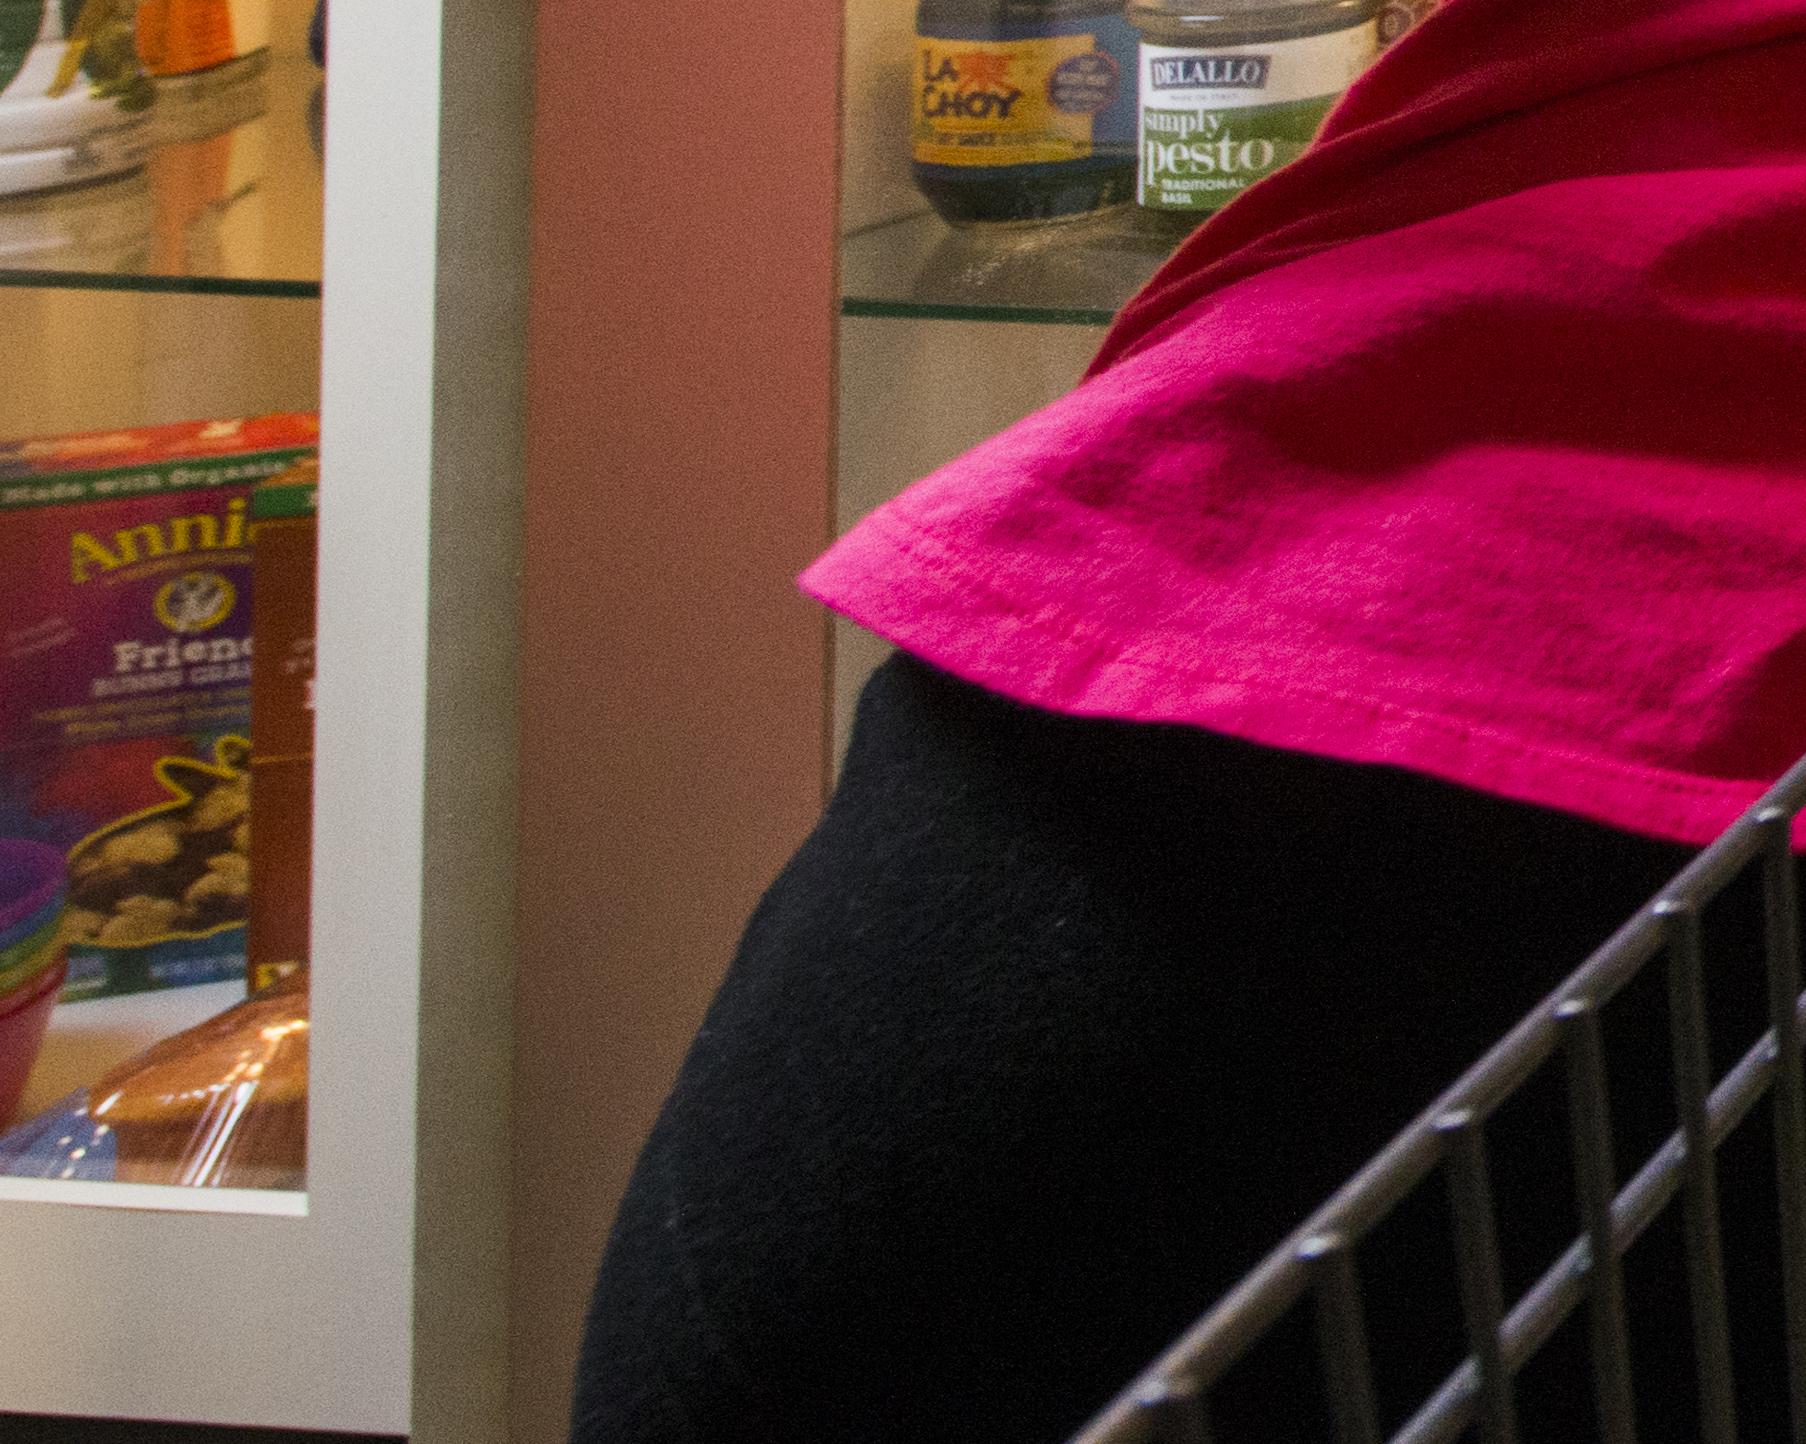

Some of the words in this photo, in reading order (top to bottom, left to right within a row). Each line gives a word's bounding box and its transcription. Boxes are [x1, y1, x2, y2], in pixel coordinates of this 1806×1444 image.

[922, 49, 960, 83] LA
[1152, 59, 1261, 86] DELALLO
[921, 84, 1023, 120] CHOY
[1144, 108, 1224, 141] simply
[1146, 128, 1275, 187] pesto
[1160, 178, 1246, 191] TRADITIONAL
[1160, 192, 1193, 205] BASIL
